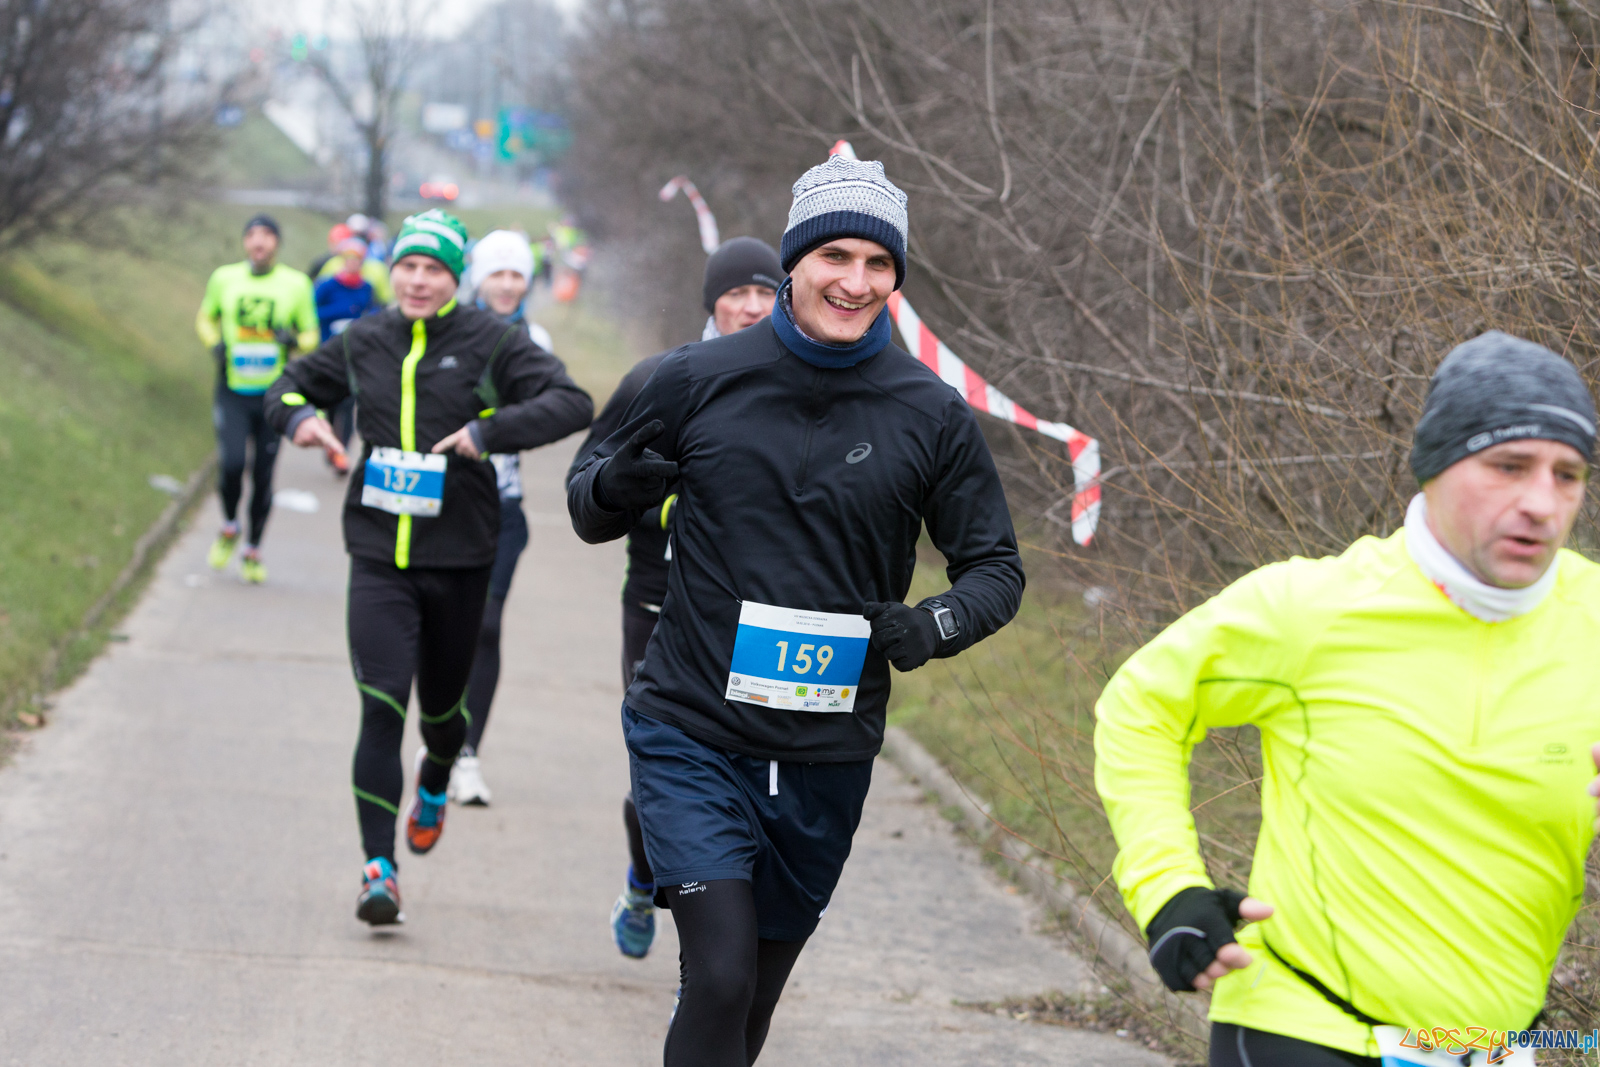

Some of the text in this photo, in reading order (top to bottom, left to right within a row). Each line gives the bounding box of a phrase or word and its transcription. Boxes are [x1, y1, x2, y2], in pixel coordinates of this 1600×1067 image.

[383, 467, 421, 492] 137
[775, 640, 834, 676] 159
[679, 885, 707, 895] Kalenji
